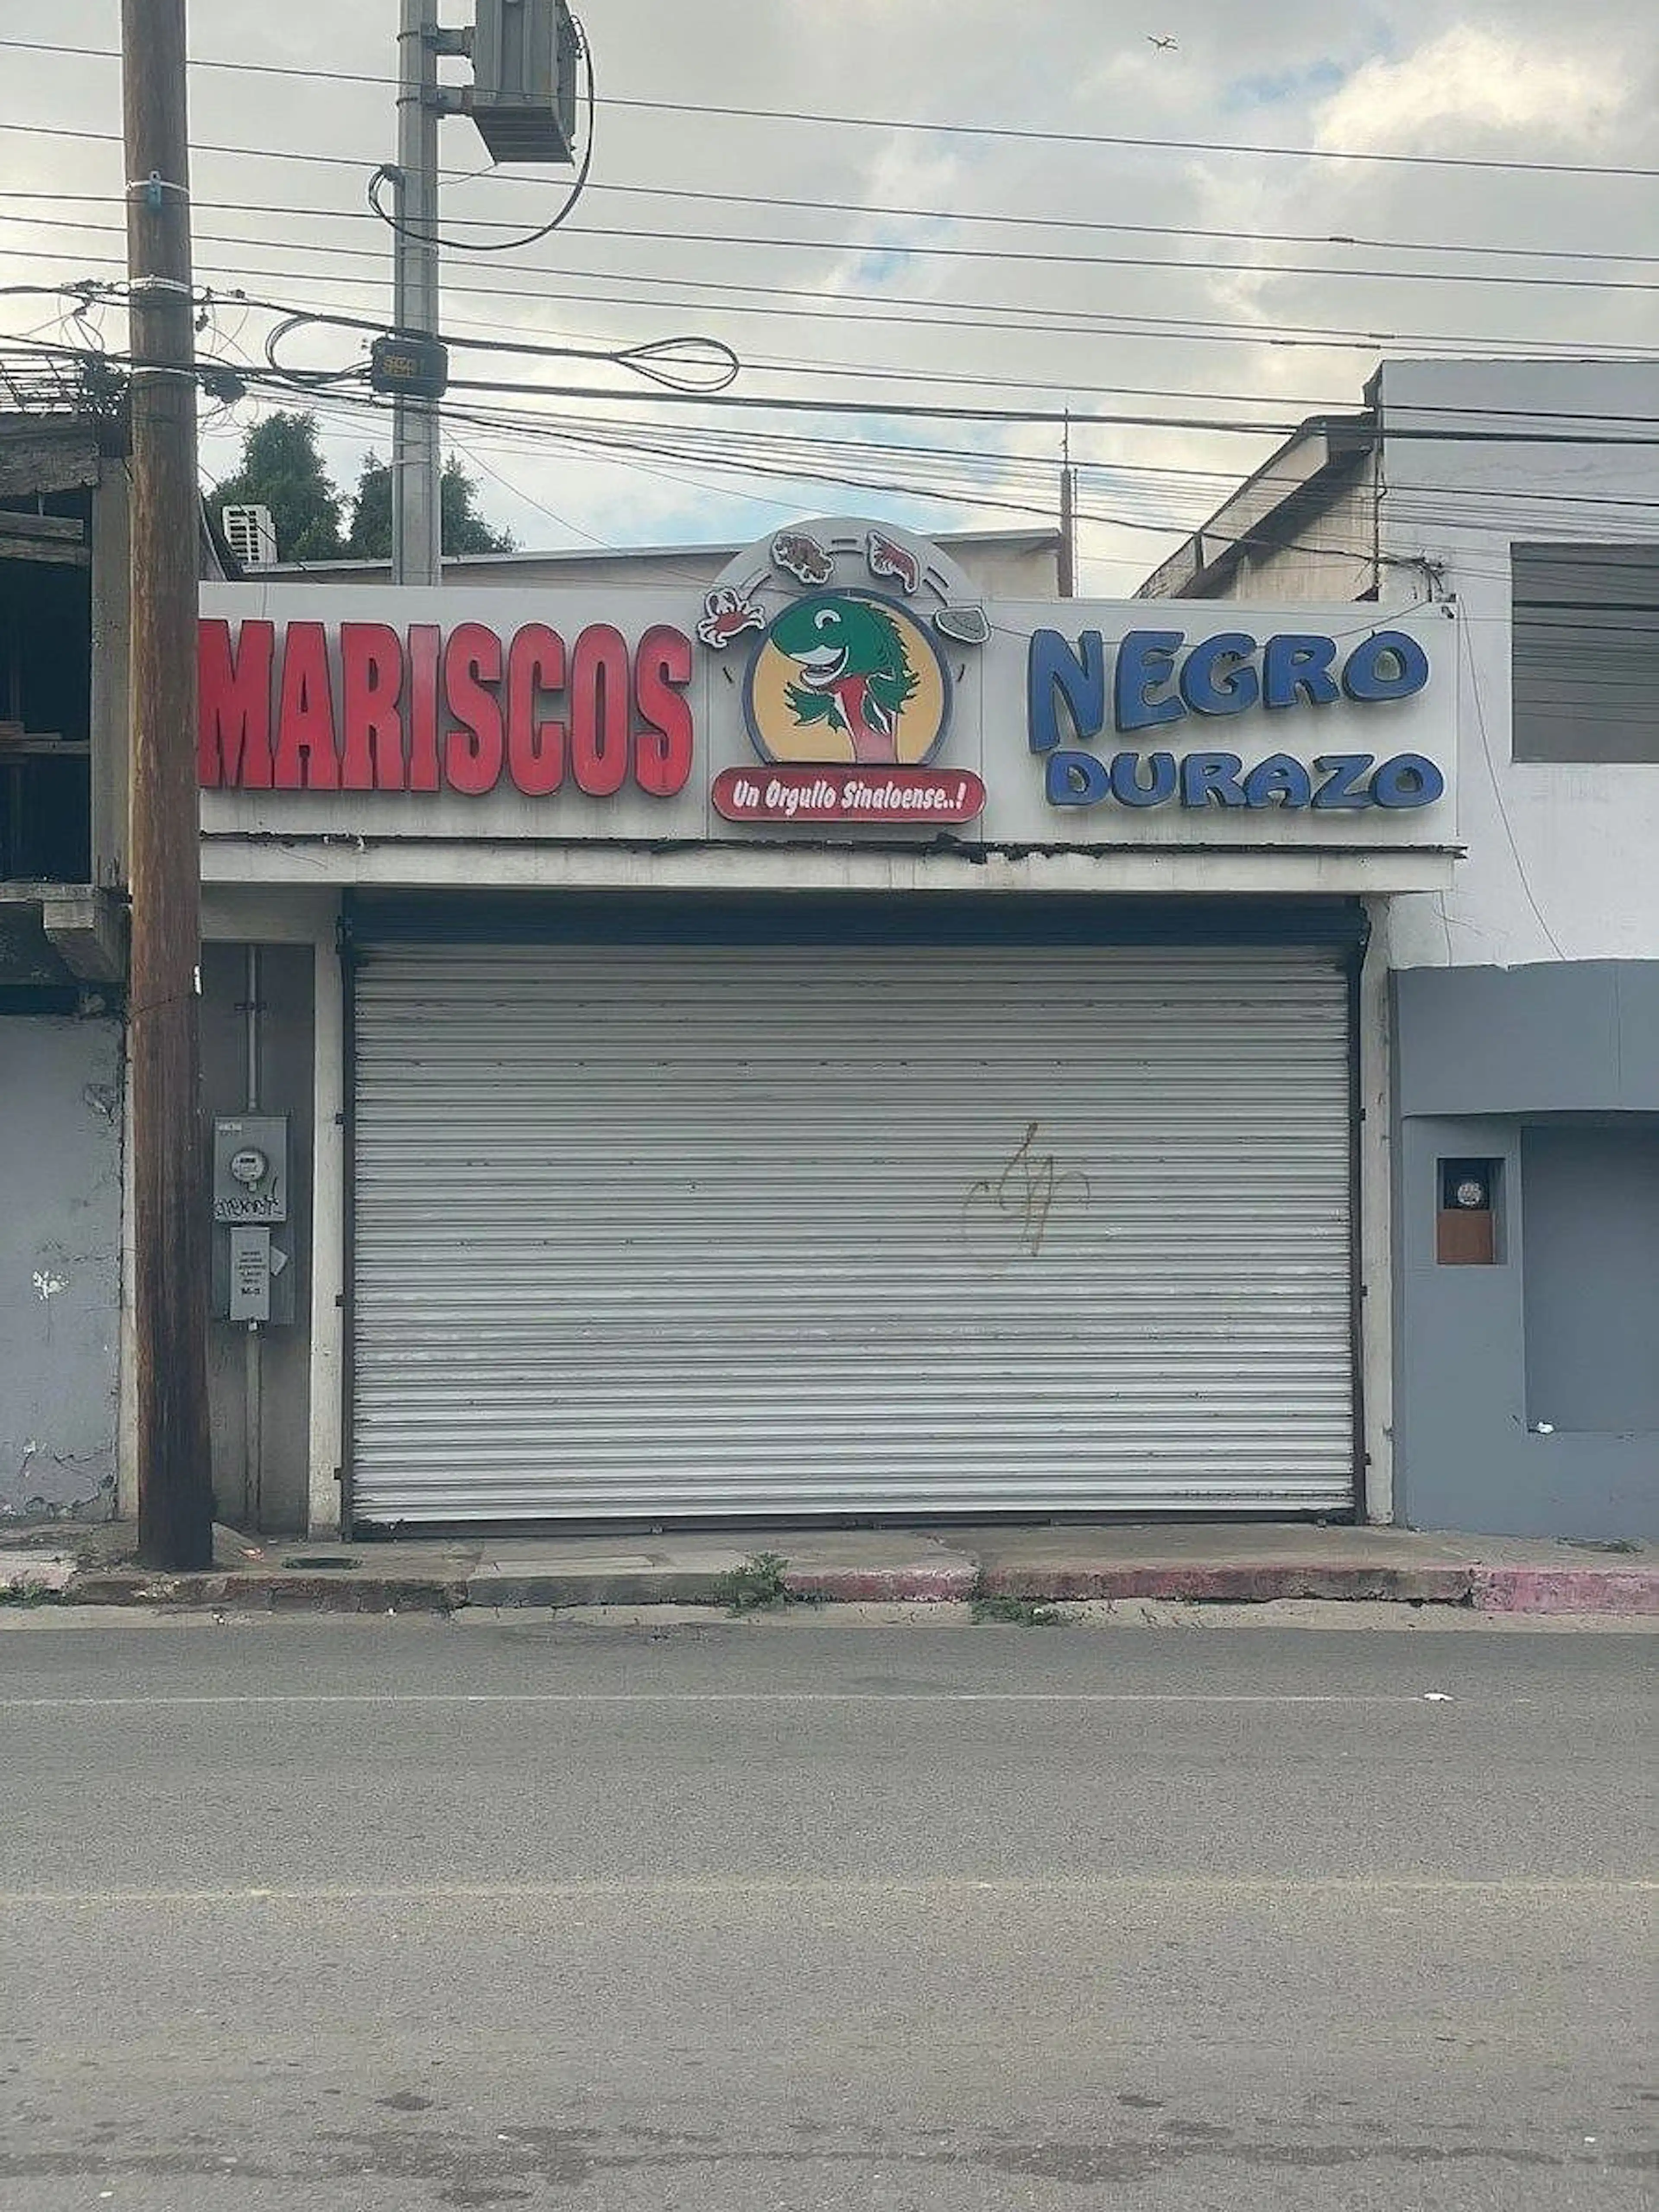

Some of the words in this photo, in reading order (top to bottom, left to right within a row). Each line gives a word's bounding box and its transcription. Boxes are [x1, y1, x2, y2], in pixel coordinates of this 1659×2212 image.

[199, 620, 693, 796] MARISCOS
[1028, 629, 1428, 753] NEGRO
[732, 780, 760, 807] Un
[766, 779, 836, 816] Orgullo
[1046, 751, 1444, 809] DURAZO
